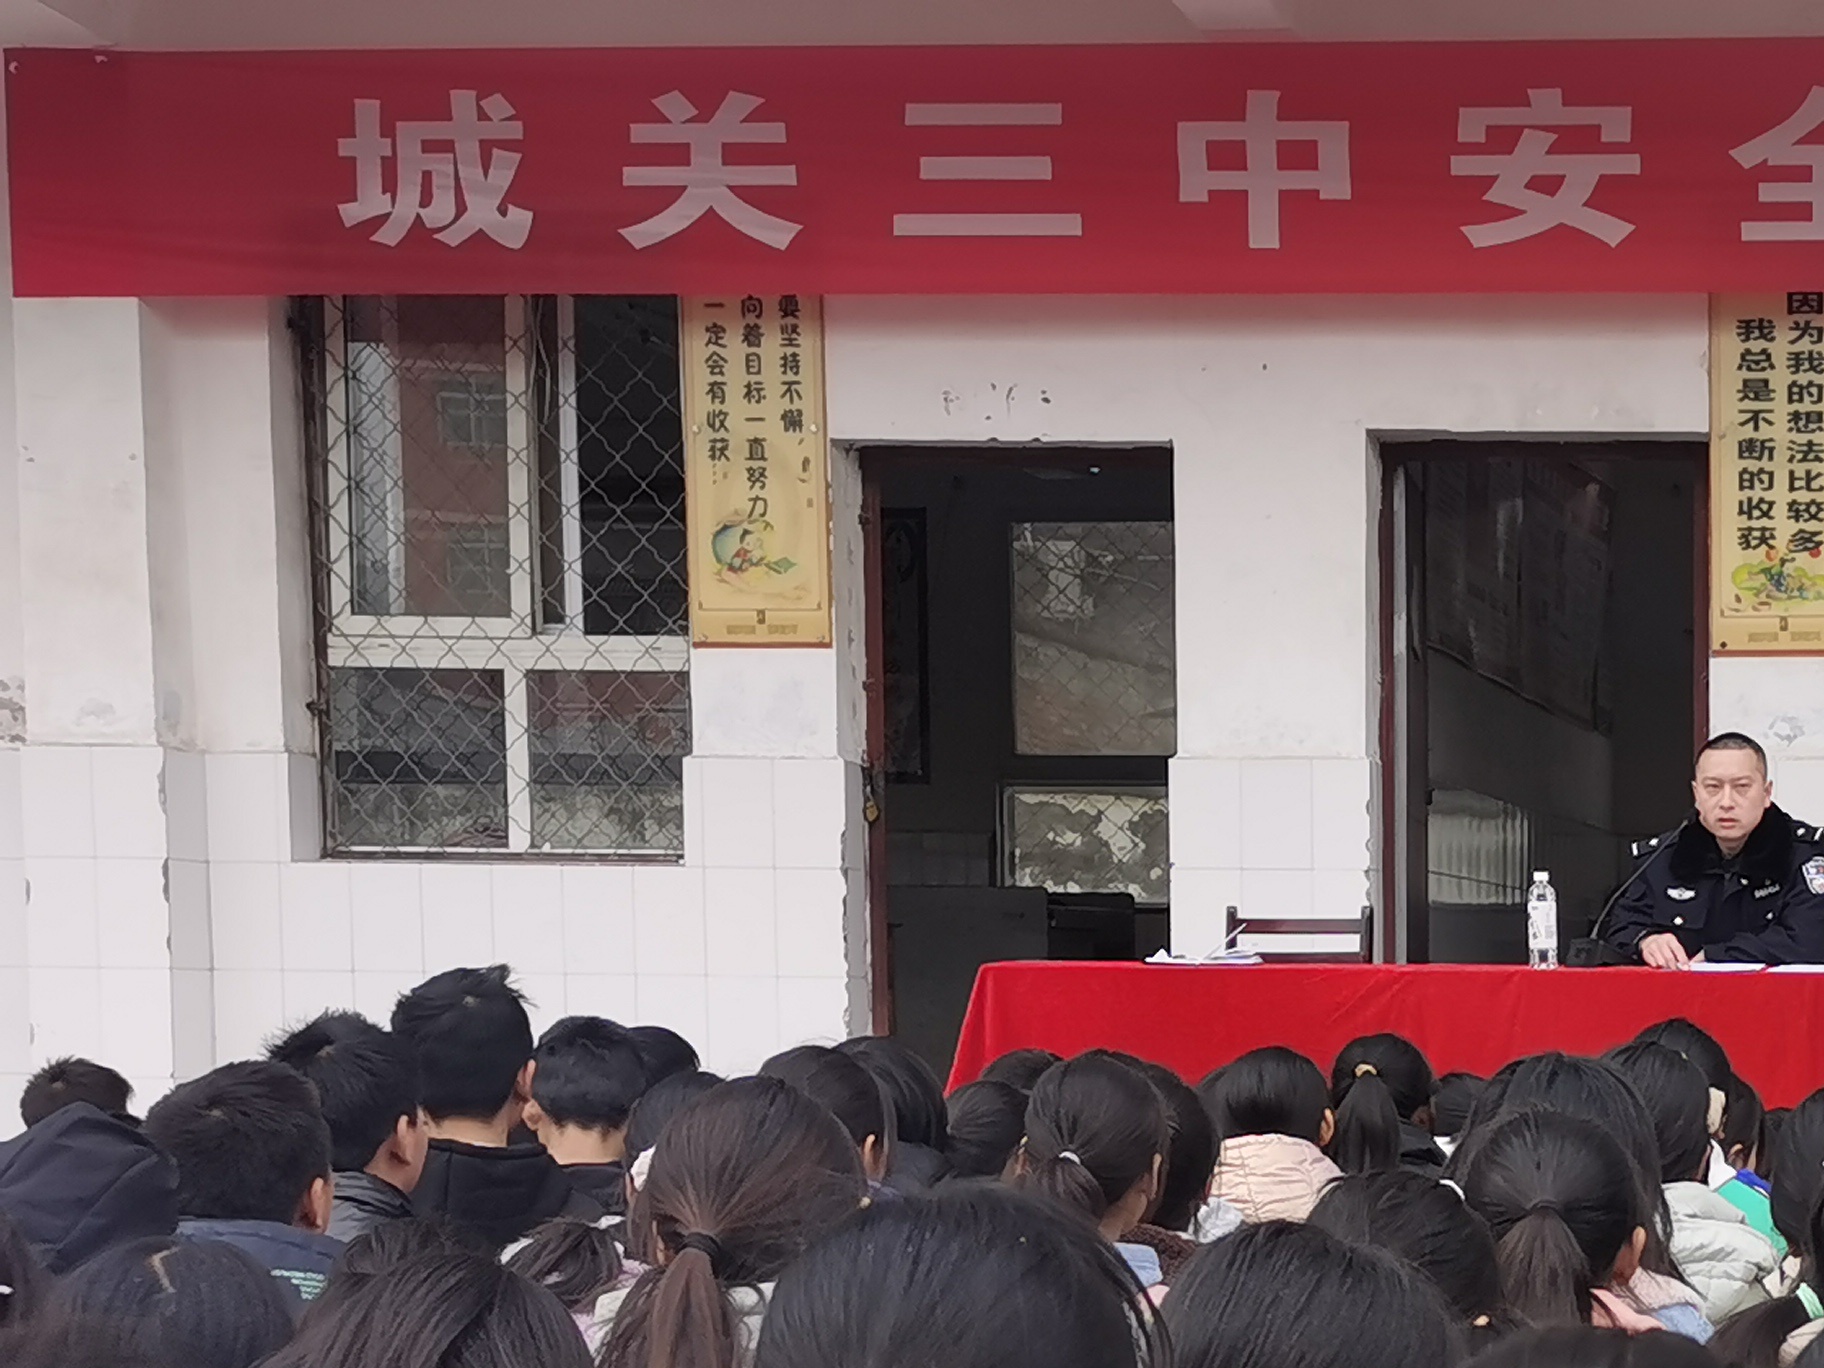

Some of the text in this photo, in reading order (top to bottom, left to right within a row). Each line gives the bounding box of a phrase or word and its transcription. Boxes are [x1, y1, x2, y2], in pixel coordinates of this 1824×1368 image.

[740, 293, 769, 519] 向着目标一直努力
[1735, 316, 1777, 551] 我总是不断的收获
